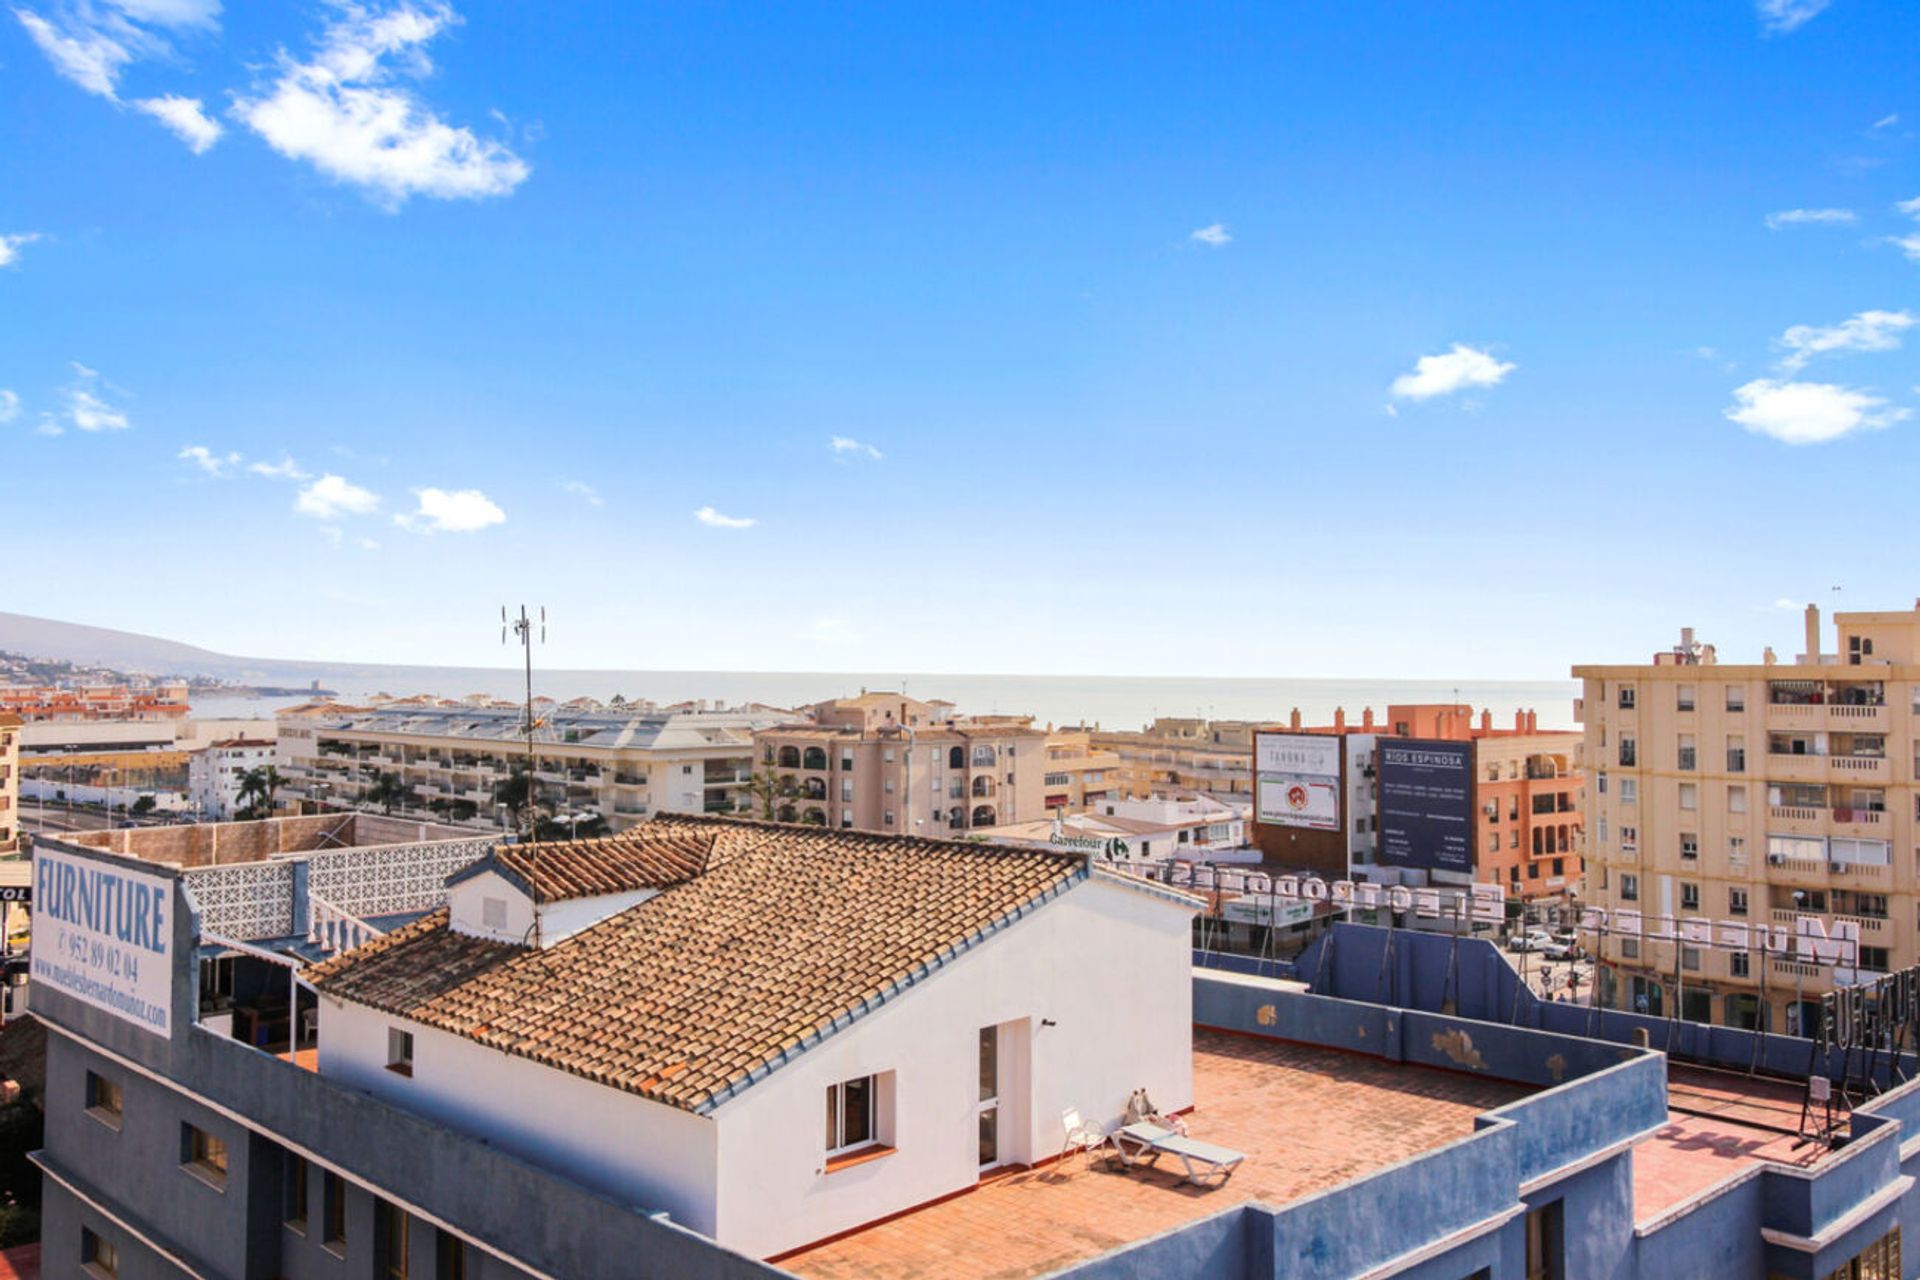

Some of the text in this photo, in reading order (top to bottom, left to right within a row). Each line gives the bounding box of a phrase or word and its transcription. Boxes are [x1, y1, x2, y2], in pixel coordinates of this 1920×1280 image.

[1411, 753, 1462, 766] ESPINOSA
[1050, 832, 1102, 849] Carrefour
[0, 888, 25, 900] OL
[38, 856, 165, 954] FURNITURE
[68, 935, 138, 983] 952 89 02 04
